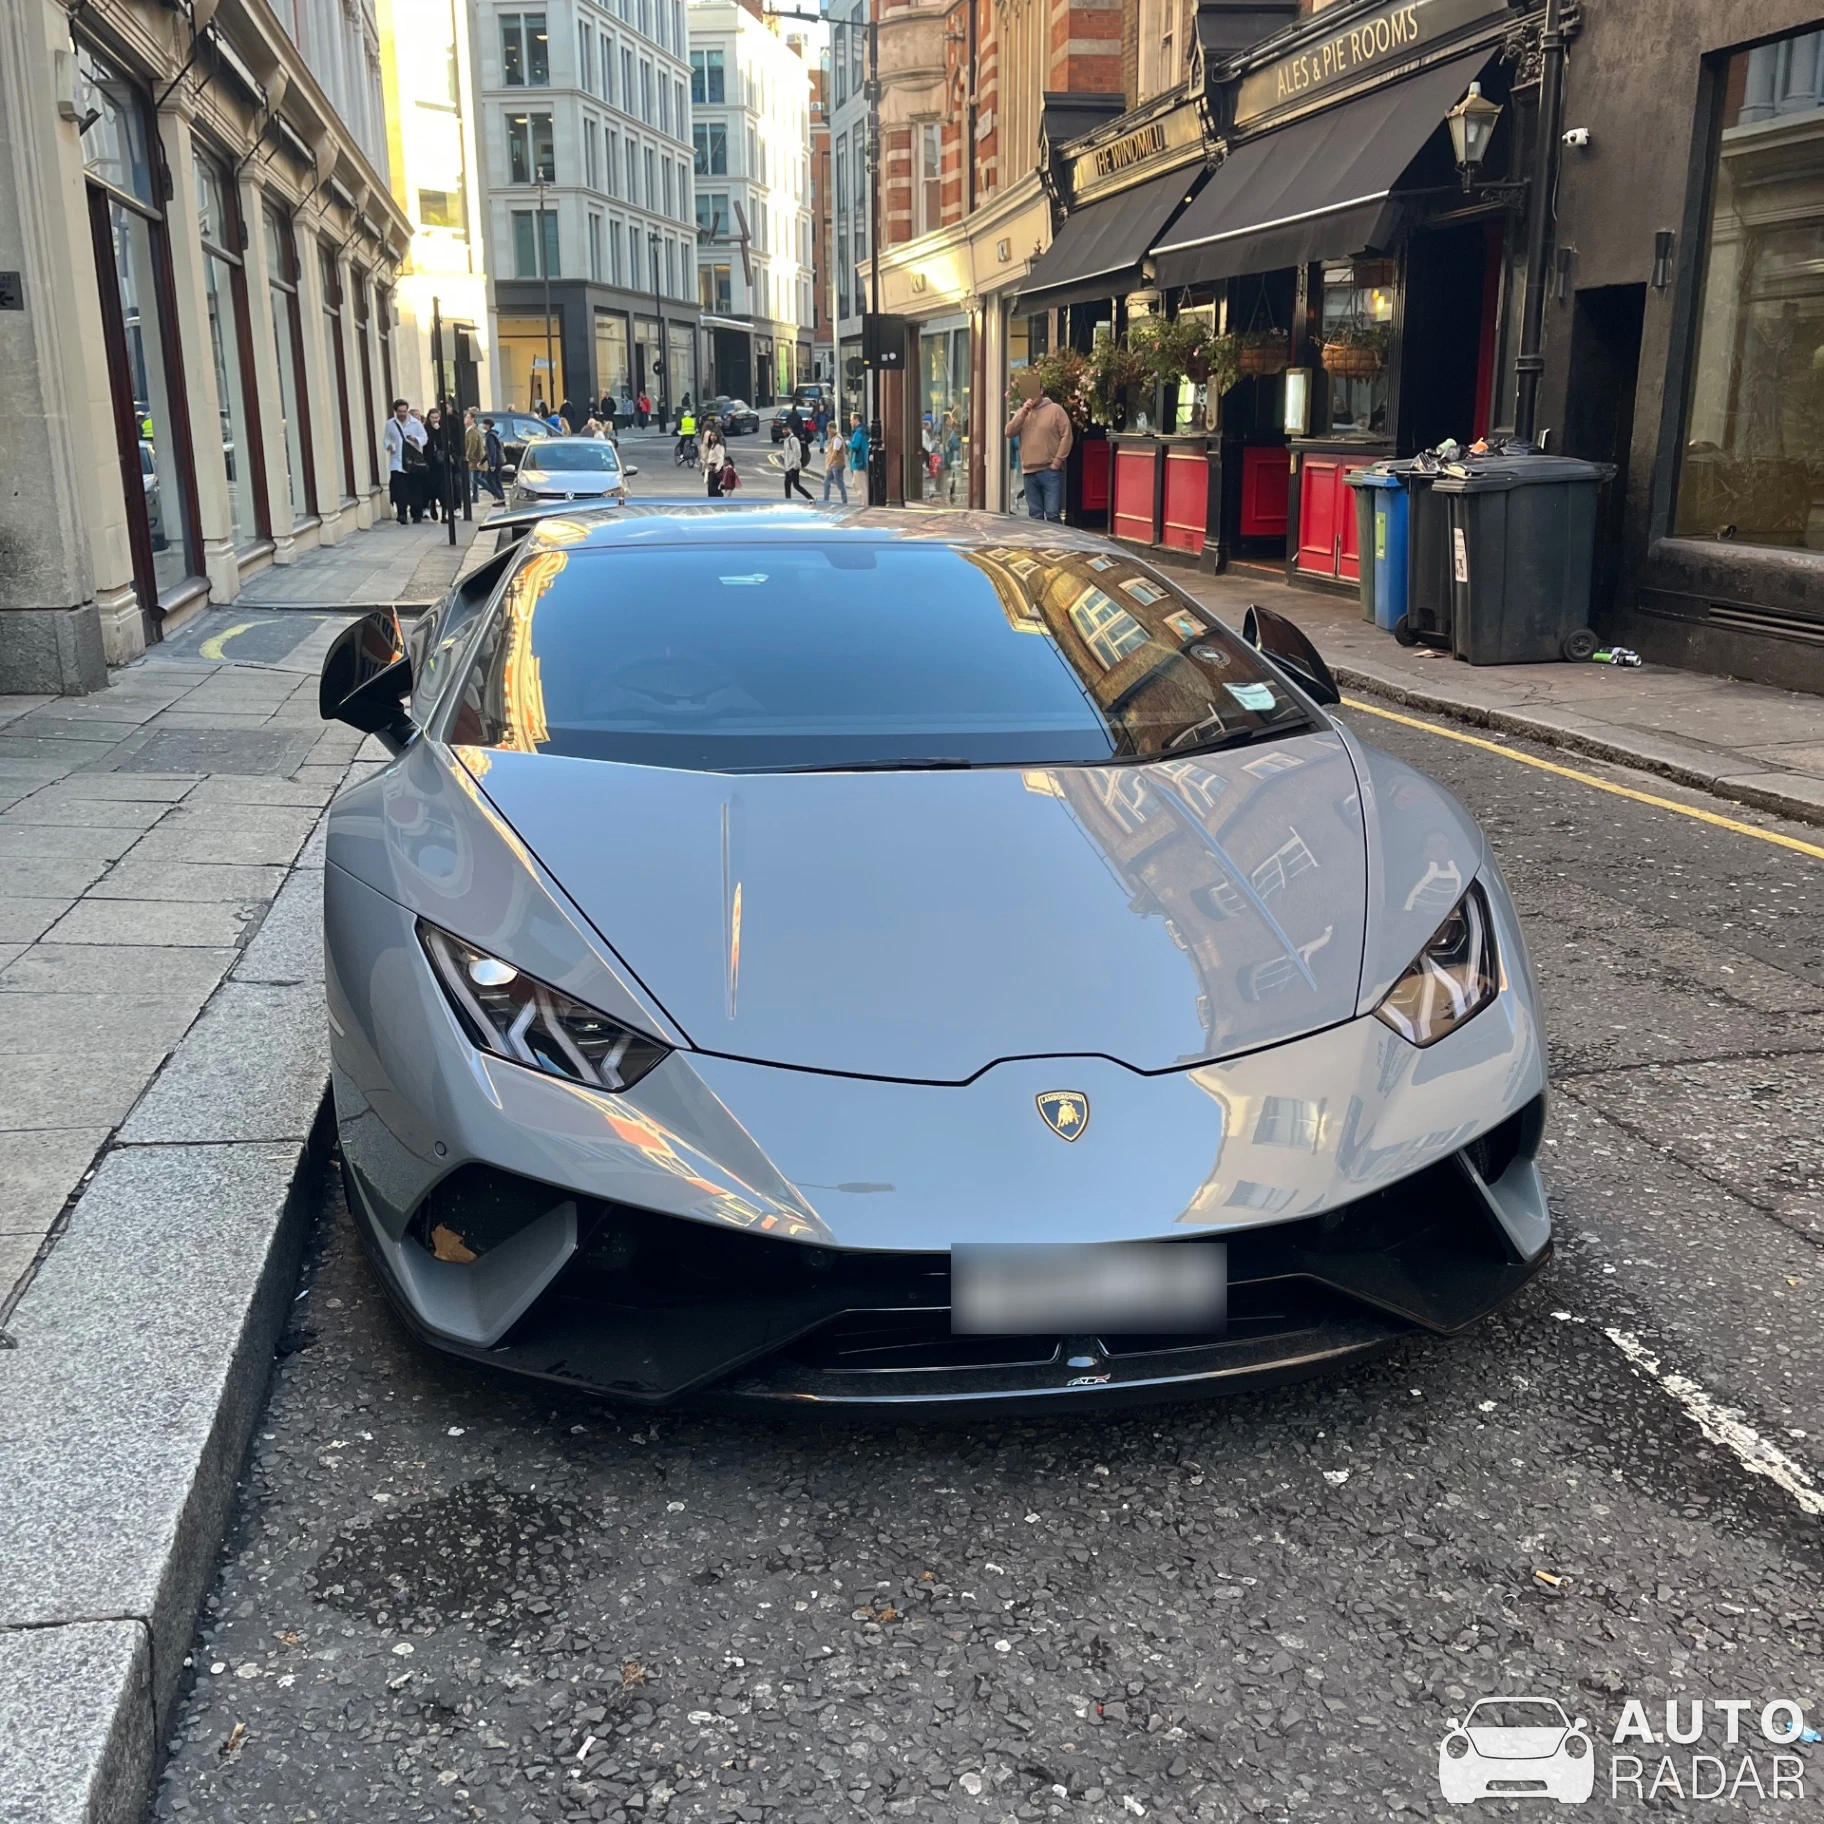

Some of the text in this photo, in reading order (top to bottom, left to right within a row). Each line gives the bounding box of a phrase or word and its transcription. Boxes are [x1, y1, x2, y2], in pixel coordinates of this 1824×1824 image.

[1277, 5, 1418, 99] ALES & PIE ROOMS
[1111, 124, 1165, 169] WINDMILL
